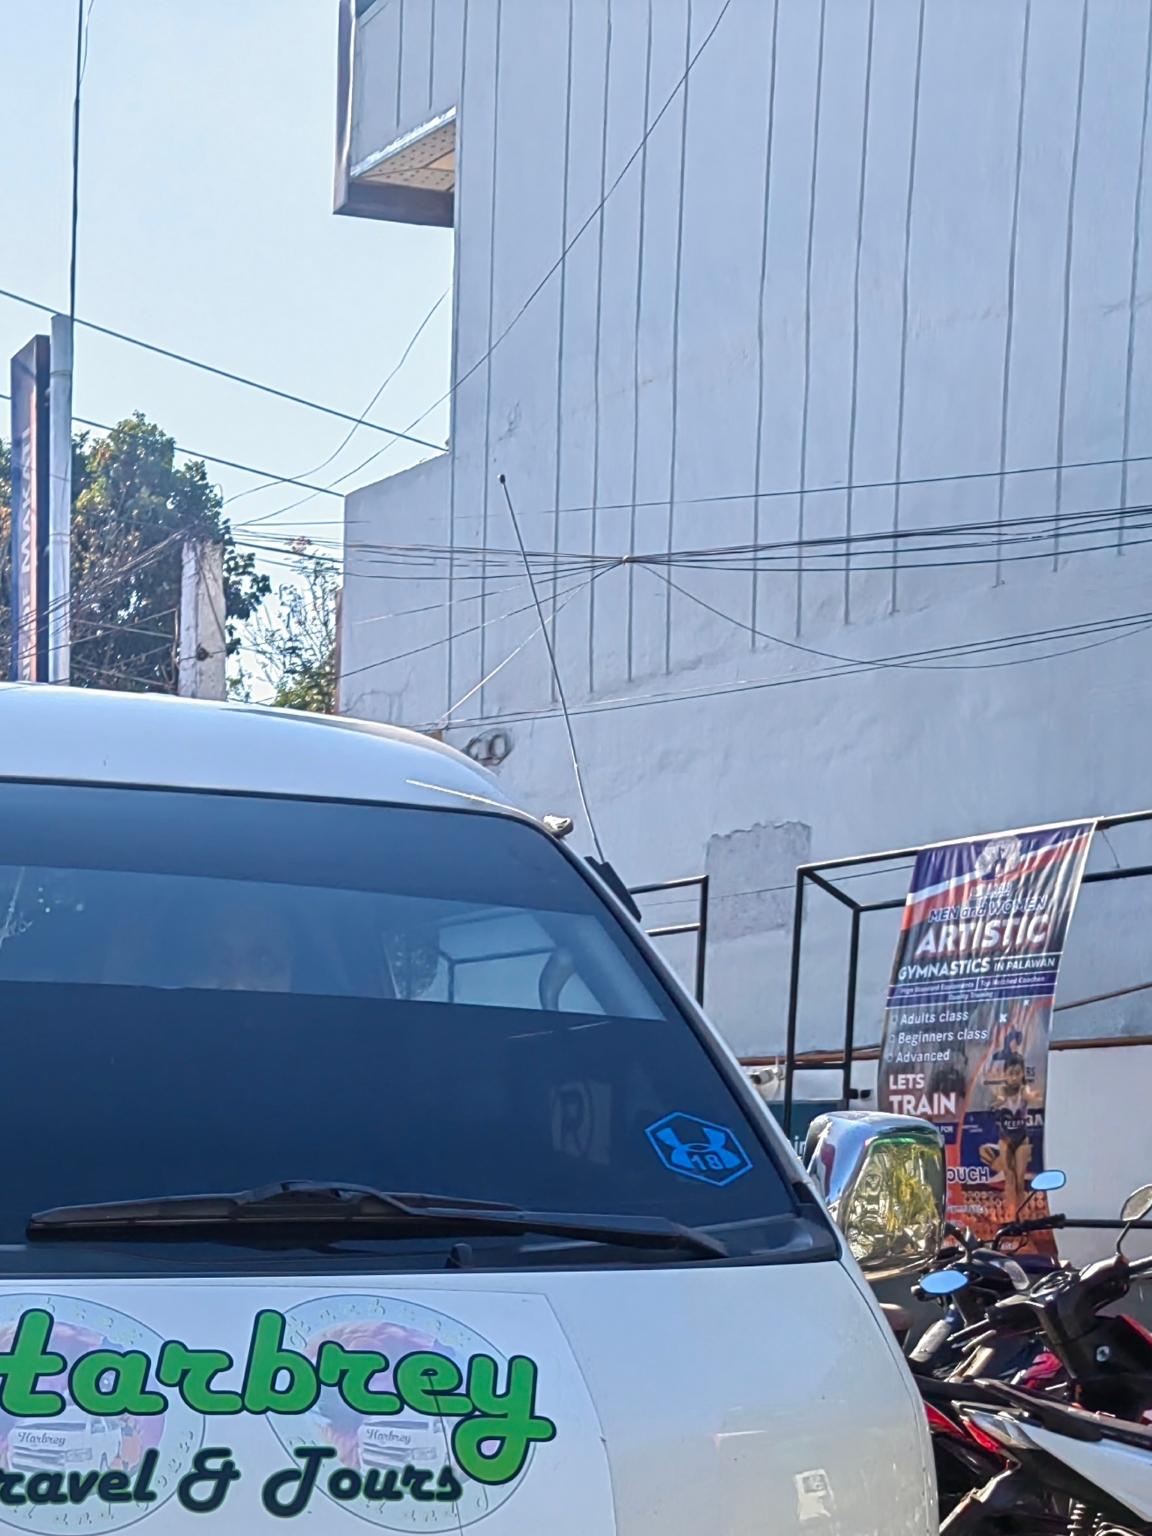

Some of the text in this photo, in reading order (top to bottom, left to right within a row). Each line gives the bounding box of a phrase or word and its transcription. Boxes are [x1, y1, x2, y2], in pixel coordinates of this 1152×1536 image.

[928, 894, 1048, 922] MEN and WOMEN
[914, 913, 1049, 955] ARTISTIC
[898, 957, 1056, 980] GYMNASTICS IN PALAWAN
[900, 1010, 969, 1025] Adults class
[898, 1028, 989, 1046] Beginners class
[895, 1048, 950, 1064] Advanced
[889, 1073, 925, 1090] LETS
[889, 1092, 957, 1116] TRAIN
[17, 1431, 67, 1447] Harbrey
[365, 1428, 412, 1445] Harbrey
[176, 1447, 240, 1513] &
[261, 1445, 464, 1518] Tours
